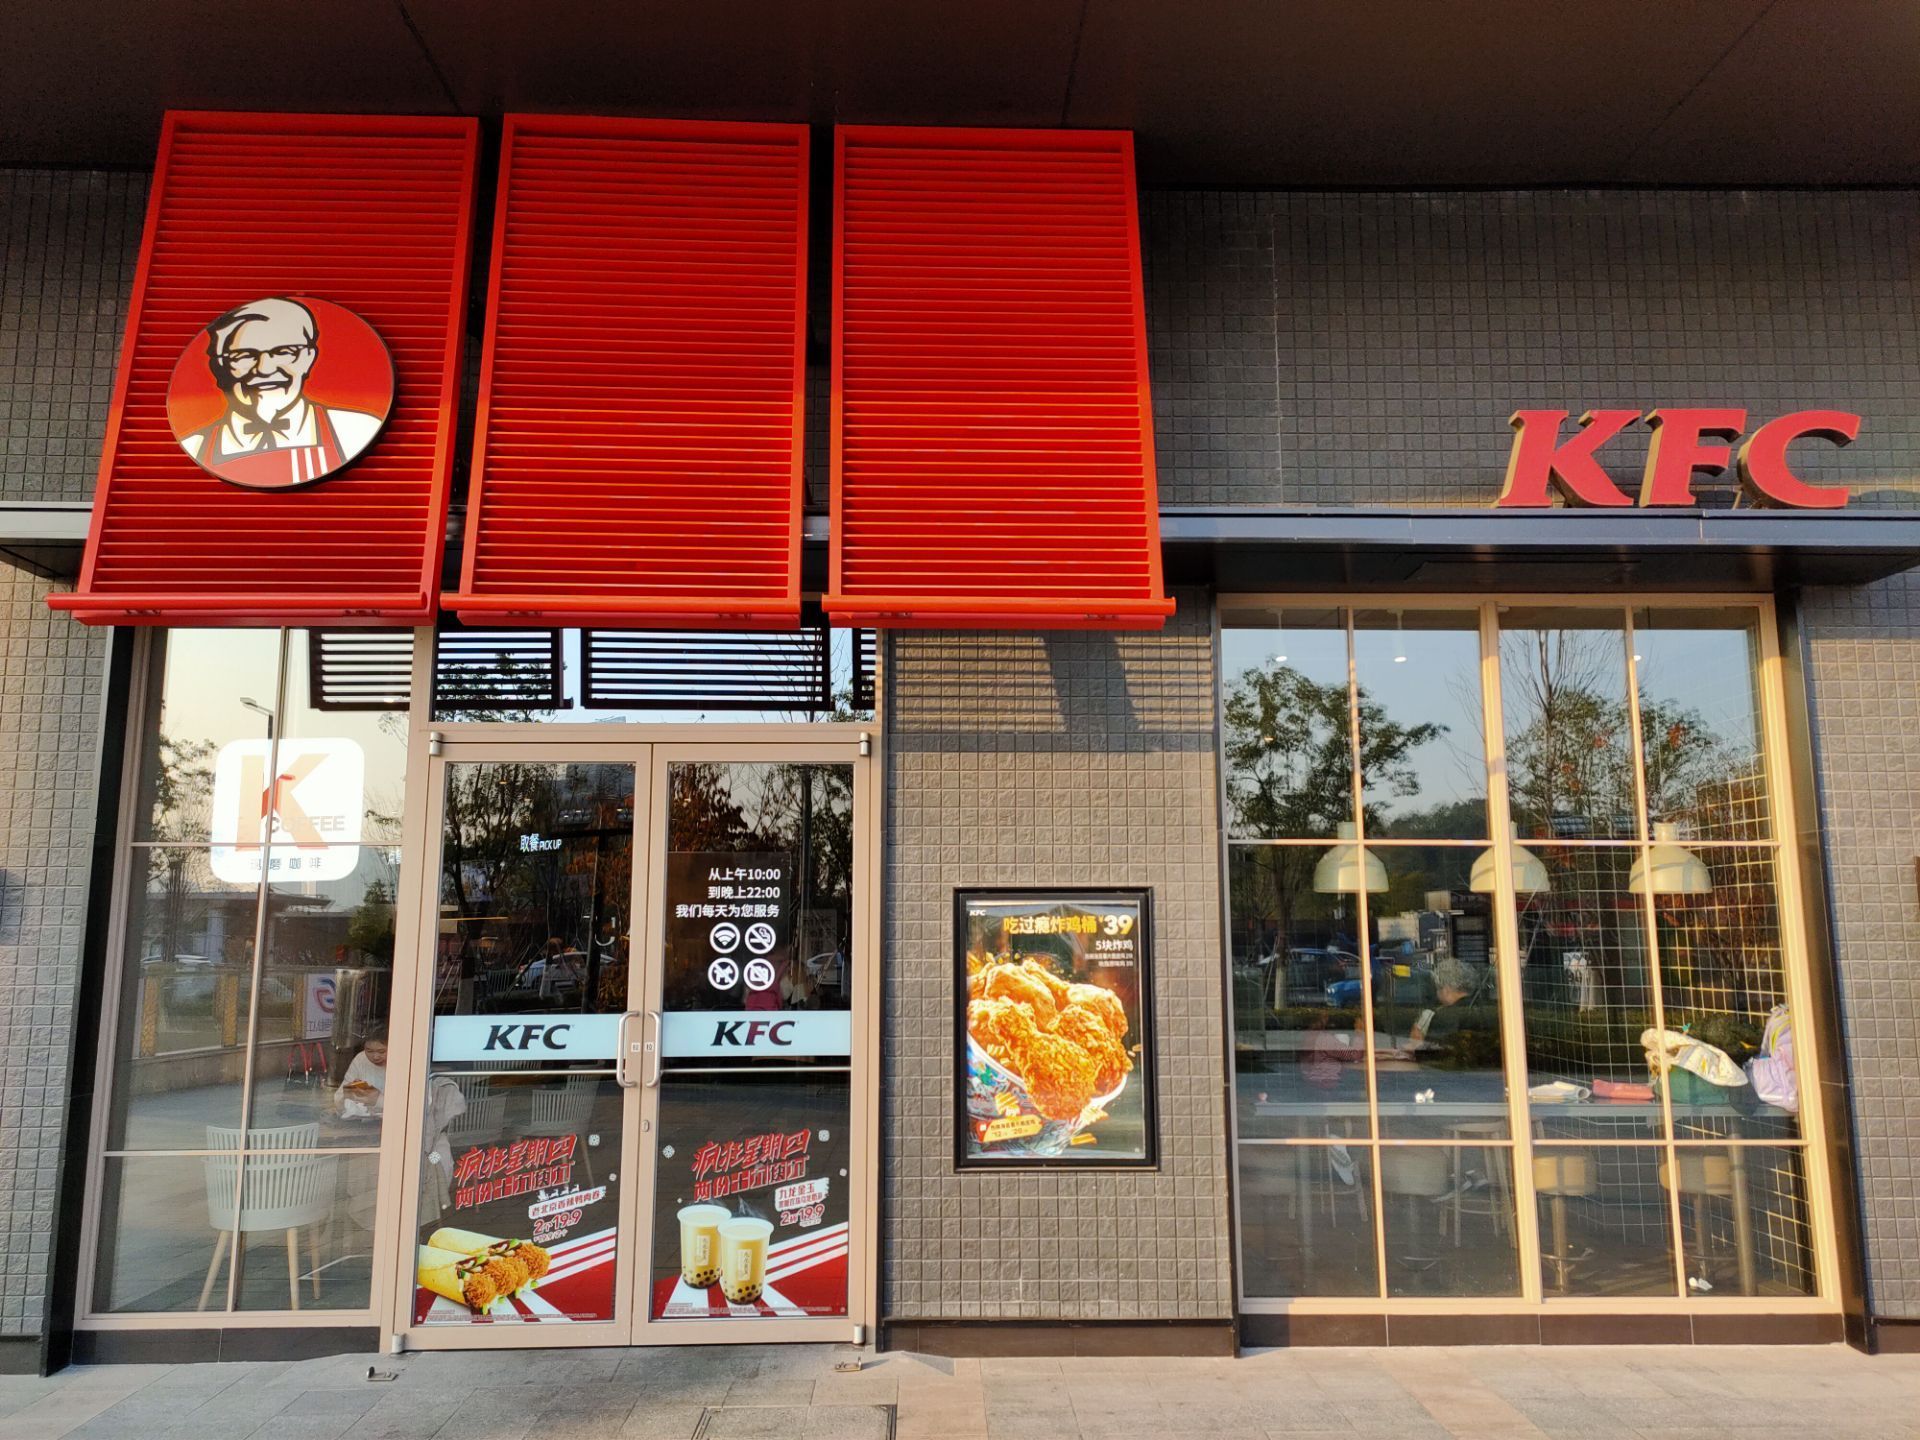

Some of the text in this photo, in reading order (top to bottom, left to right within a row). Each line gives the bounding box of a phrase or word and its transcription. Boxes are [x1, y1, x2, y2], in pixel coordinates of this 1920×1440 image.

[1495, 408, 1862, 509] KFC
[235, 753, 329, 852] K
[520, 833, 562, 852] 取餐 PICK UP
[708, 867, 781, 881] 从上午10:00
[708, 886, 780, 899] 到晚上22:00
[675, 903, 780, 918] 我们每天为您服务
[969, 909, 987, 917] KFC
[1003, 914, 1097, 935] 吃过瘾炸鸡桶
[1095, 939, 1134, 951] 5块炸鸡
[483, 1023, 571, 1051] KFC
[710, 1020, 796, 1046] KFC
[454, 1133, 578, 1188] 疯狂星期四
[690, 1128, 811, 1181] 疯狂星期四
